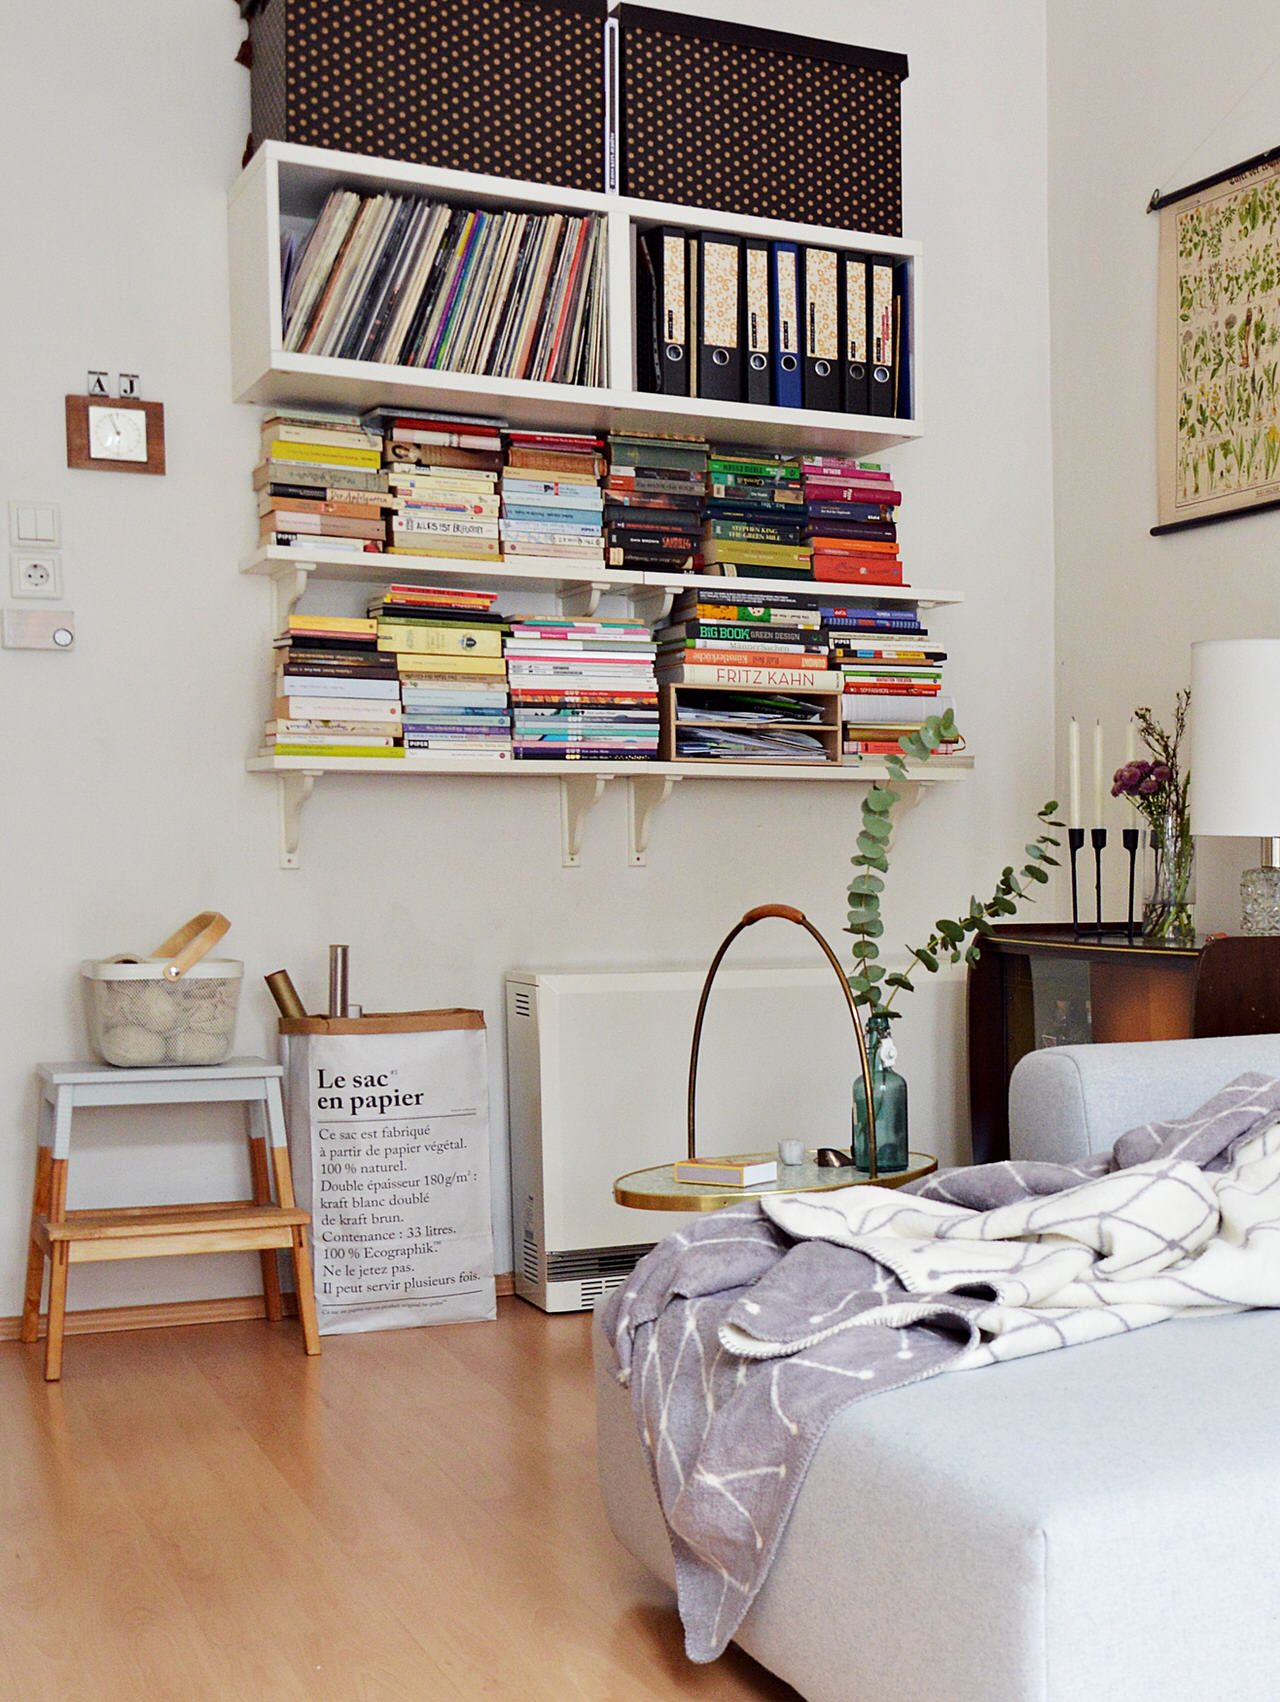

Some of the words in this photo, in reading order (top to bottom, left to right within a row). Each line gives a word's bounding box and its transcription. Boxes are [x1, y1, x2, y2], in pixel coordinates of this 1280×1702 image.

[91, 376, 106, 393] A
[123, 379, 134, 395] J
[719, 627, 751, 640] BOOK
[751, 630, 774, 640] GREEN
[775, 631, 801, 641] DESIGN
[716, 668, 763, 685] FRITZ
[768, 671, 815, 687] KAHN
[409, 740, 429, 748] PIPER
[317, 1068, 346, 1089] Le
[352, 1072, 389, 1088] sac
[317, 1093, 343, 1109] en
[350, 1089, 424, 1116] papier
[319, 1128, 336, 1141] Ce
[340, 1131, 356, 1140] sac
[360, 1129, 378, 1139] est
[382, 1124, 430, 1142] fabriqué
[319, 1147, 326, 1157] à
[329, 1145, 361, 1161] partir
[365, 1144, 380, 1156] de
[384, 1142, 421, 1159] papier
[424, 1138, 467, 1155] végétal.
[320, 1163, 342, 1175] 100
[344, 1163, 357, 1174] %
[360, 1159, 407, 1174] naturel.
[320, 1179, 363, 1192] Double
[367, 1177, 420, 1194] épaisseur
[320, 1196, 348, 1210] kraft
[352, 1195, 385, 1208] blanc
[389, 1192, 430, 1206] doublé
[321, 1214, 336, 1226] de
[339, 1213, 368, 1226] kraft
[371, 1213, 404, 1224] brun.
[322, 1230, 396, 1243] Contenance
[406, 1226, 422, 1239] 33
[426, 1225, 456, 1237] litres.
[323, 1248, 345, 1260] 100
[349, 1247, 360, 1258] %
[323, 1265, 341, 1277] Ne
[345, 1264, 355, 1276] le
[358, 1265, 388, 1280] jetez
[391, 1265, 415, 1277] pas.
[323, 1283, 332, 1294] Il
[336, 1282, 362, 1297] peut
[366, 1279, 401, 1293] servir
[404, 1273, 456, 1292] plusieurs
[459, 1271, 481, 1283] fois.
